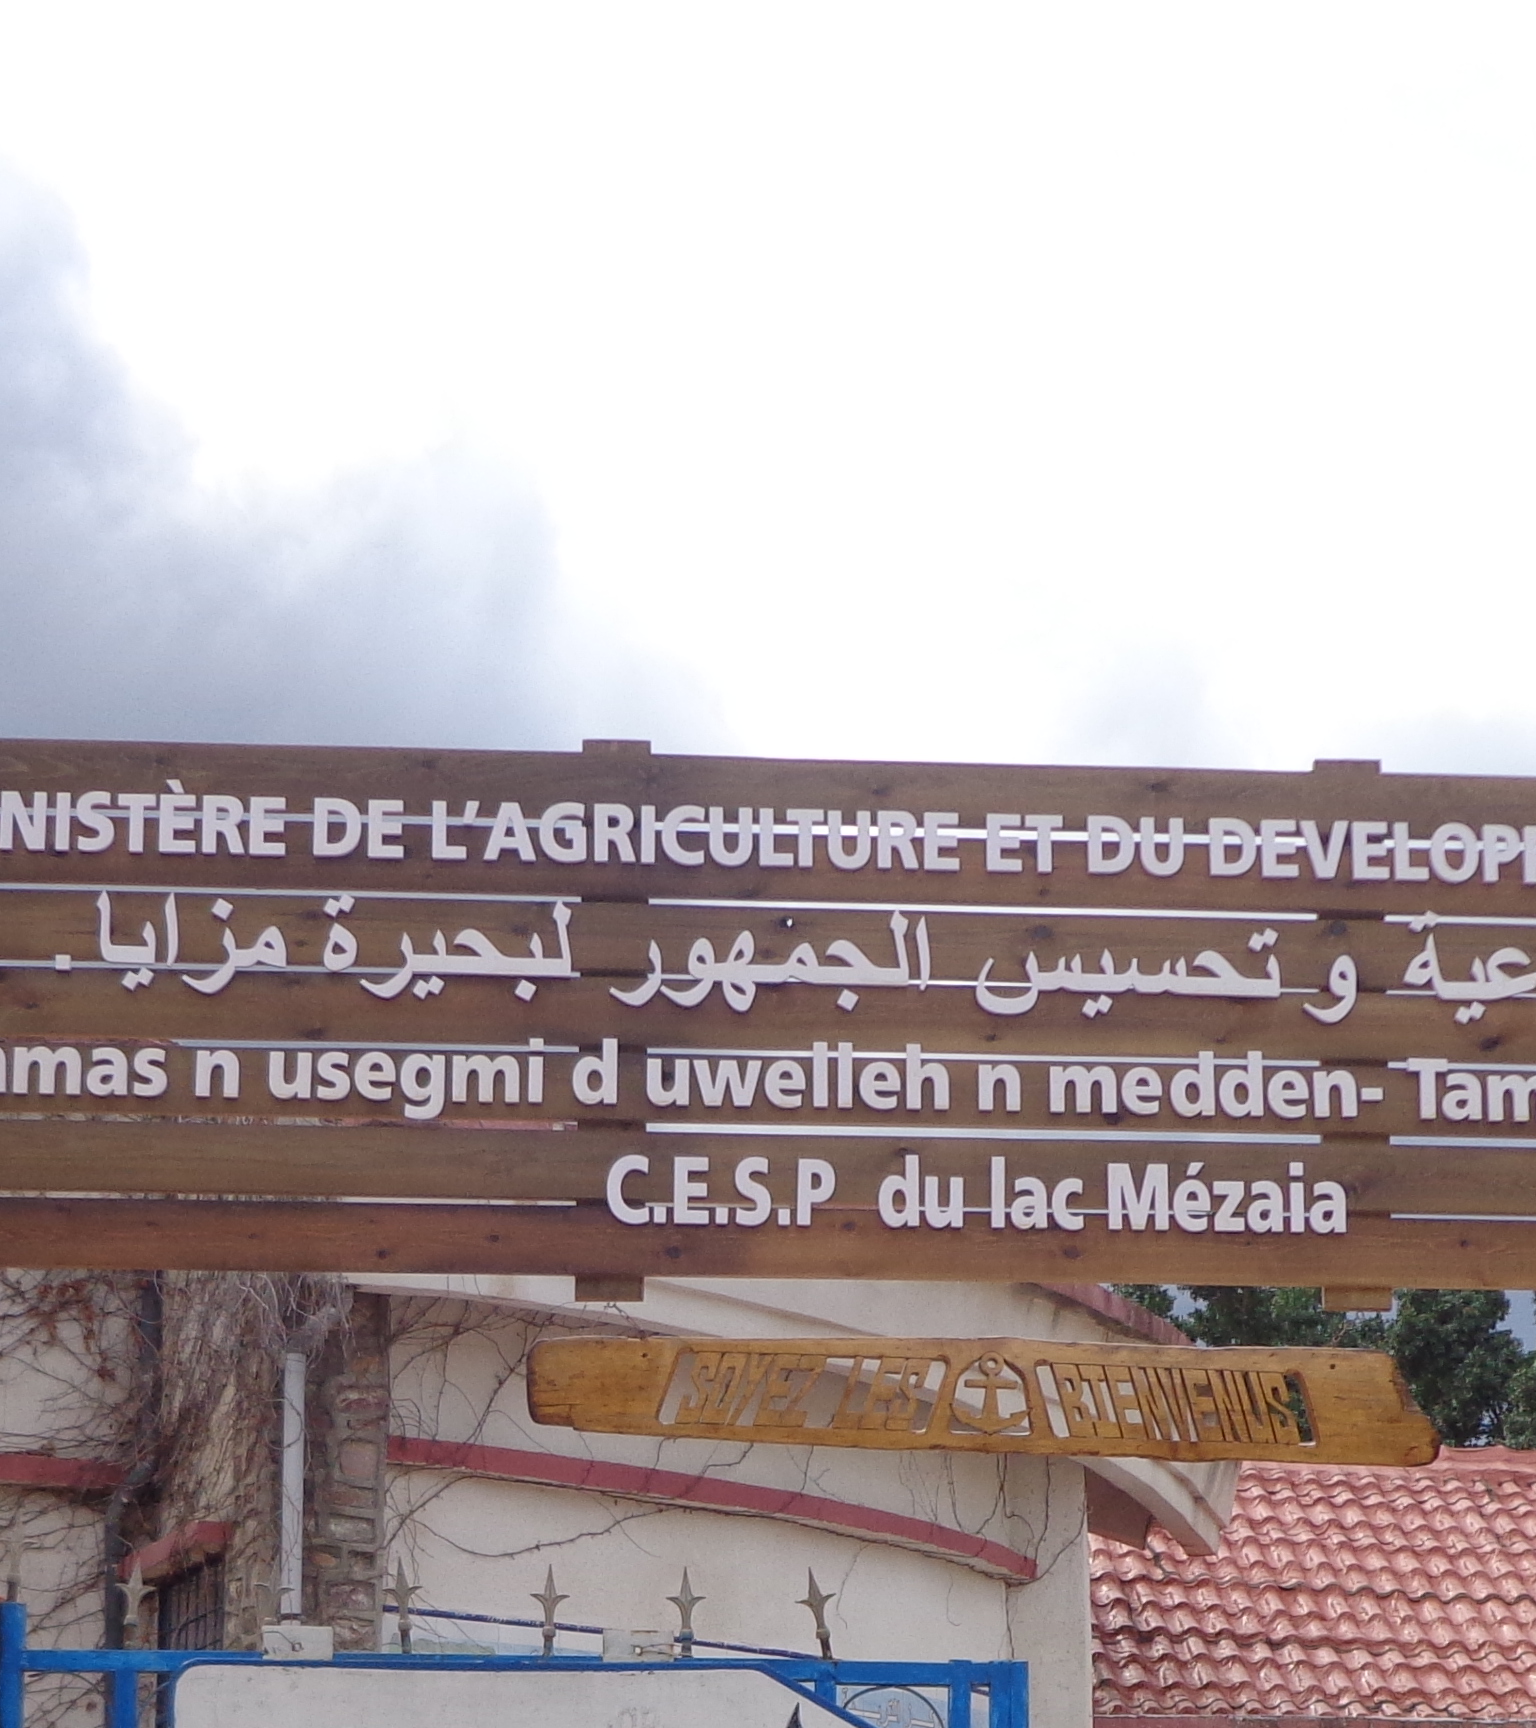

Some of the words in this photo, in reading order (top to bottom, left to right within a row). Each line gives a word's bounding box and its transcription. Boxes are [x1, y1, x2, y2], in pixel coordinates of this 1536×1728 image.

[311, 796, 406, 860] DE
[984, 812, 1064, 873] ET
[1086, 815, 1186, 877] DU
[322, 893, 573, 1002] لبحيرة
[608, 909, 932, 1013] الجمهور
[974, 927, 1282, 1019] تحسيس
[1301, 953, 1358, 1024] و
[194, 1049, 241, 1098] n
[267, 1037, 544, 1121] usegmi
[571, 1037, 619, 1106] d
[645, 1041, 951, 1112] uwelleh
[976, 1062, 1022, 1114] n
[1048, 1050, 1384, 1119] medden-
[605, 1154, 837, 1227] C.E.S.P
[877, 1154, 964, 1230] du
[990, 1155, 1085, 1231] lac
[1106, 1161, 1348, 1235] Mézaia
[675, 1352, 828, 1428] SOYEZ
[832, 1356, 932, 1432] LES
[1051, 1362, 1302, 1446] BIENVENUS
